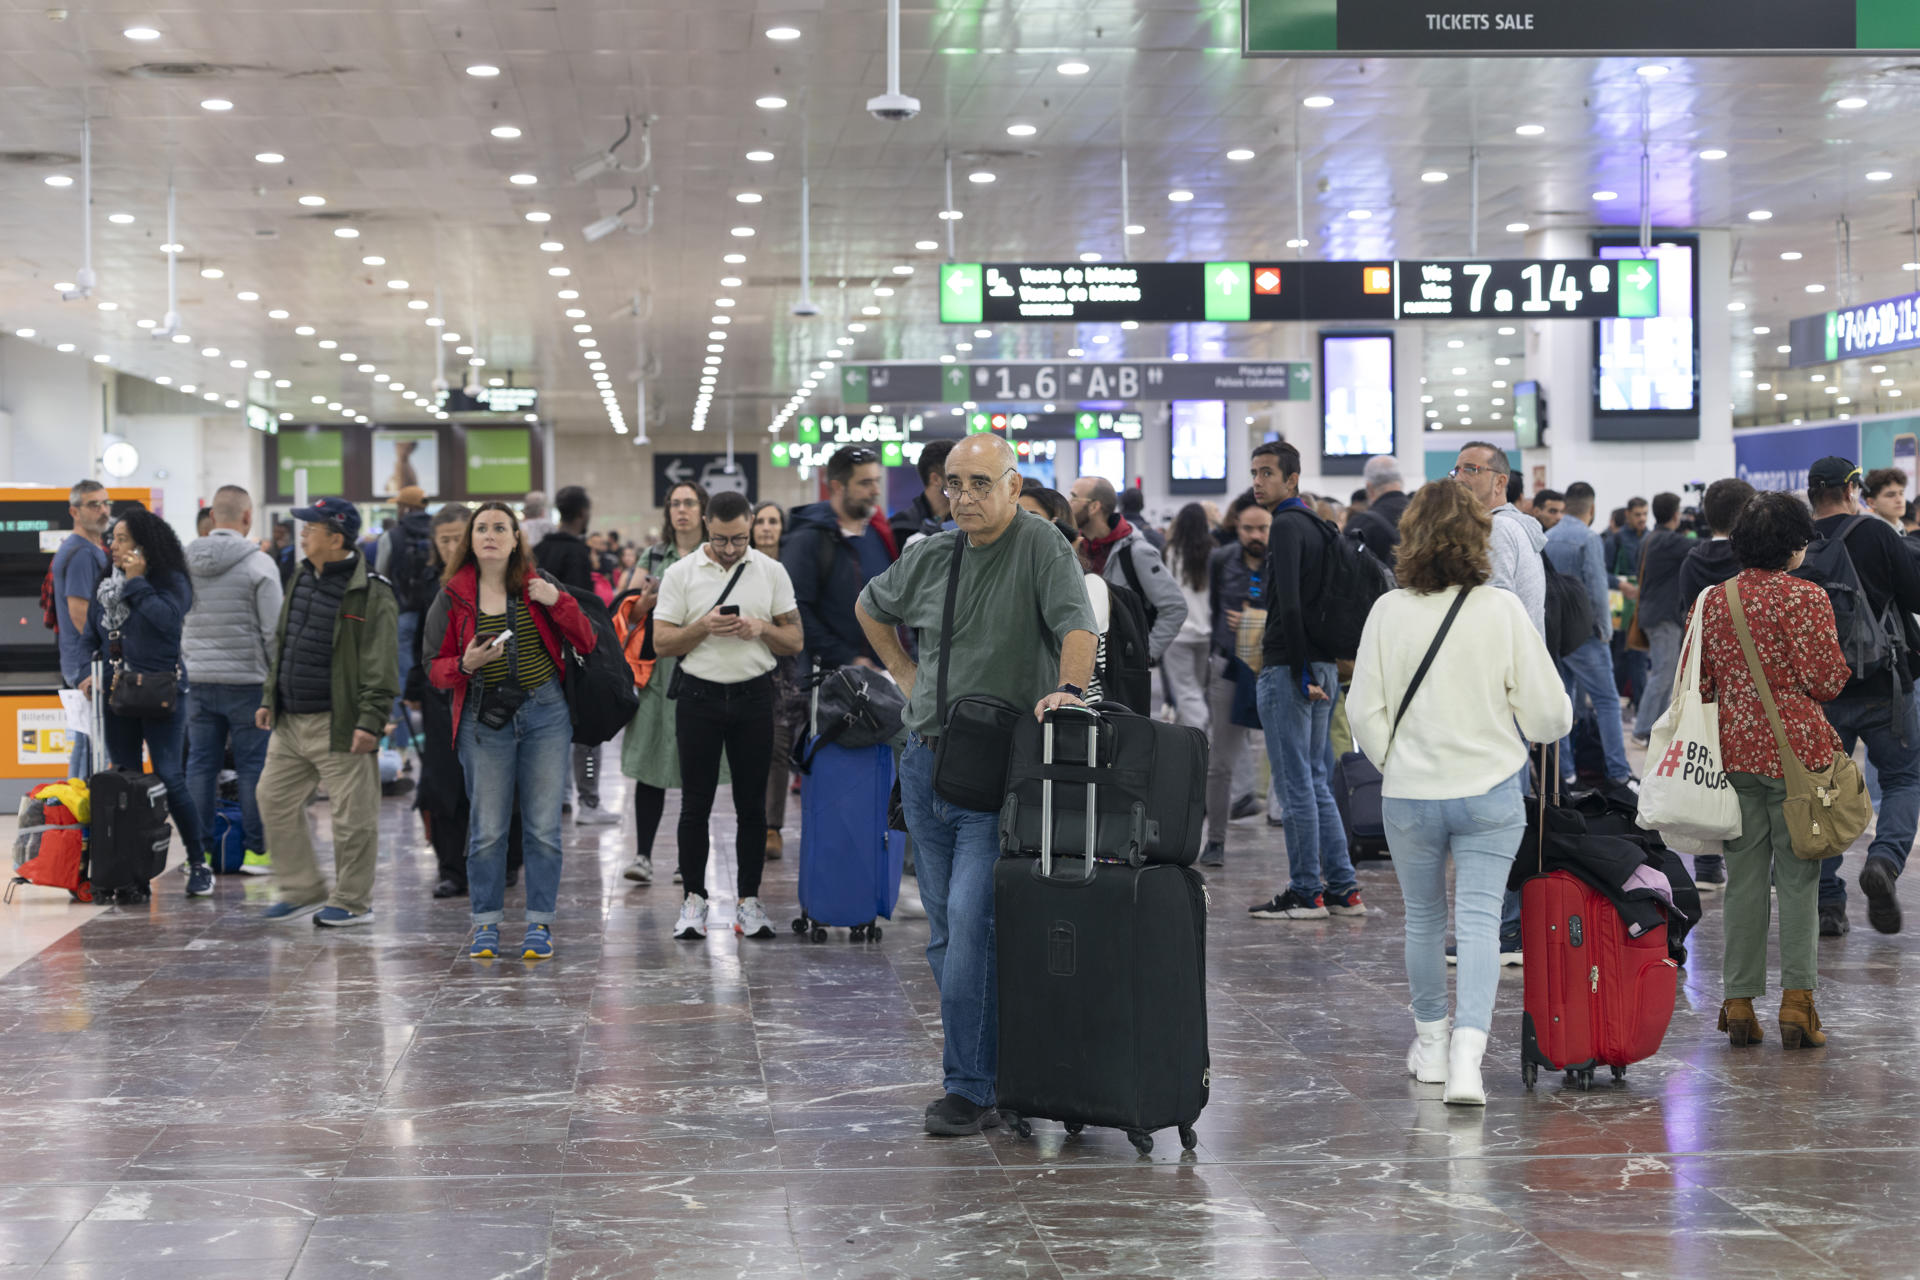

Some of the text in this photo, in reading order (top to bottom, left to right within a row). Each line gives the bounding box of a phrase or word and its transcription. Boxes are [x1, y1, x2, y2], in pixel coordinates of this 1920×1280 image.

[1426, 14, 1534, 30] TICKETS SALE
[1463, 264, 1492, 312] 7
[1521, 264, 1583, 312] 14
[995, 367, 1015, 398] 1
[1035, 367, 1056, 399] 6
[834, 415, 851, 442] 1
[861, 415, 880, 442] 6
